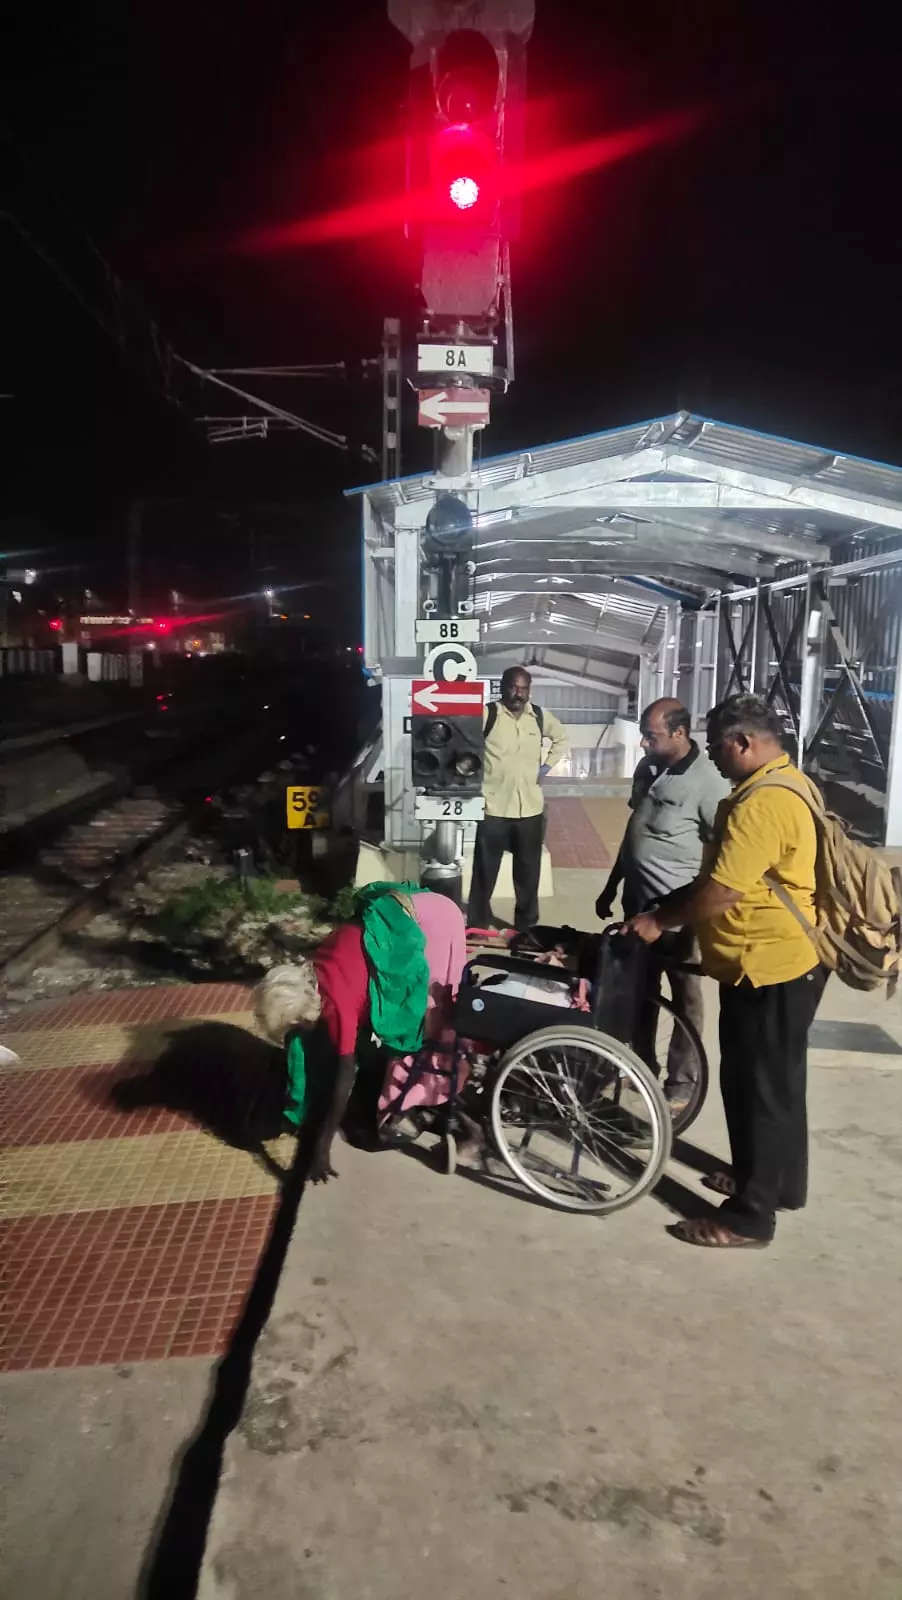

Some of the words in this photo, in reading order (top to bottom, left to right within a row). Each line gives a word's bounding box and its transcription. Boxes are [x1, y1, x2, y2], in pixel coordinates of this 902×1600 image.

[446, 350, 466, 367] 8A
[440, 623, 459, 638] 8B
[433, 651, 467, 682] C
[443, 801, 463, 815] 28
